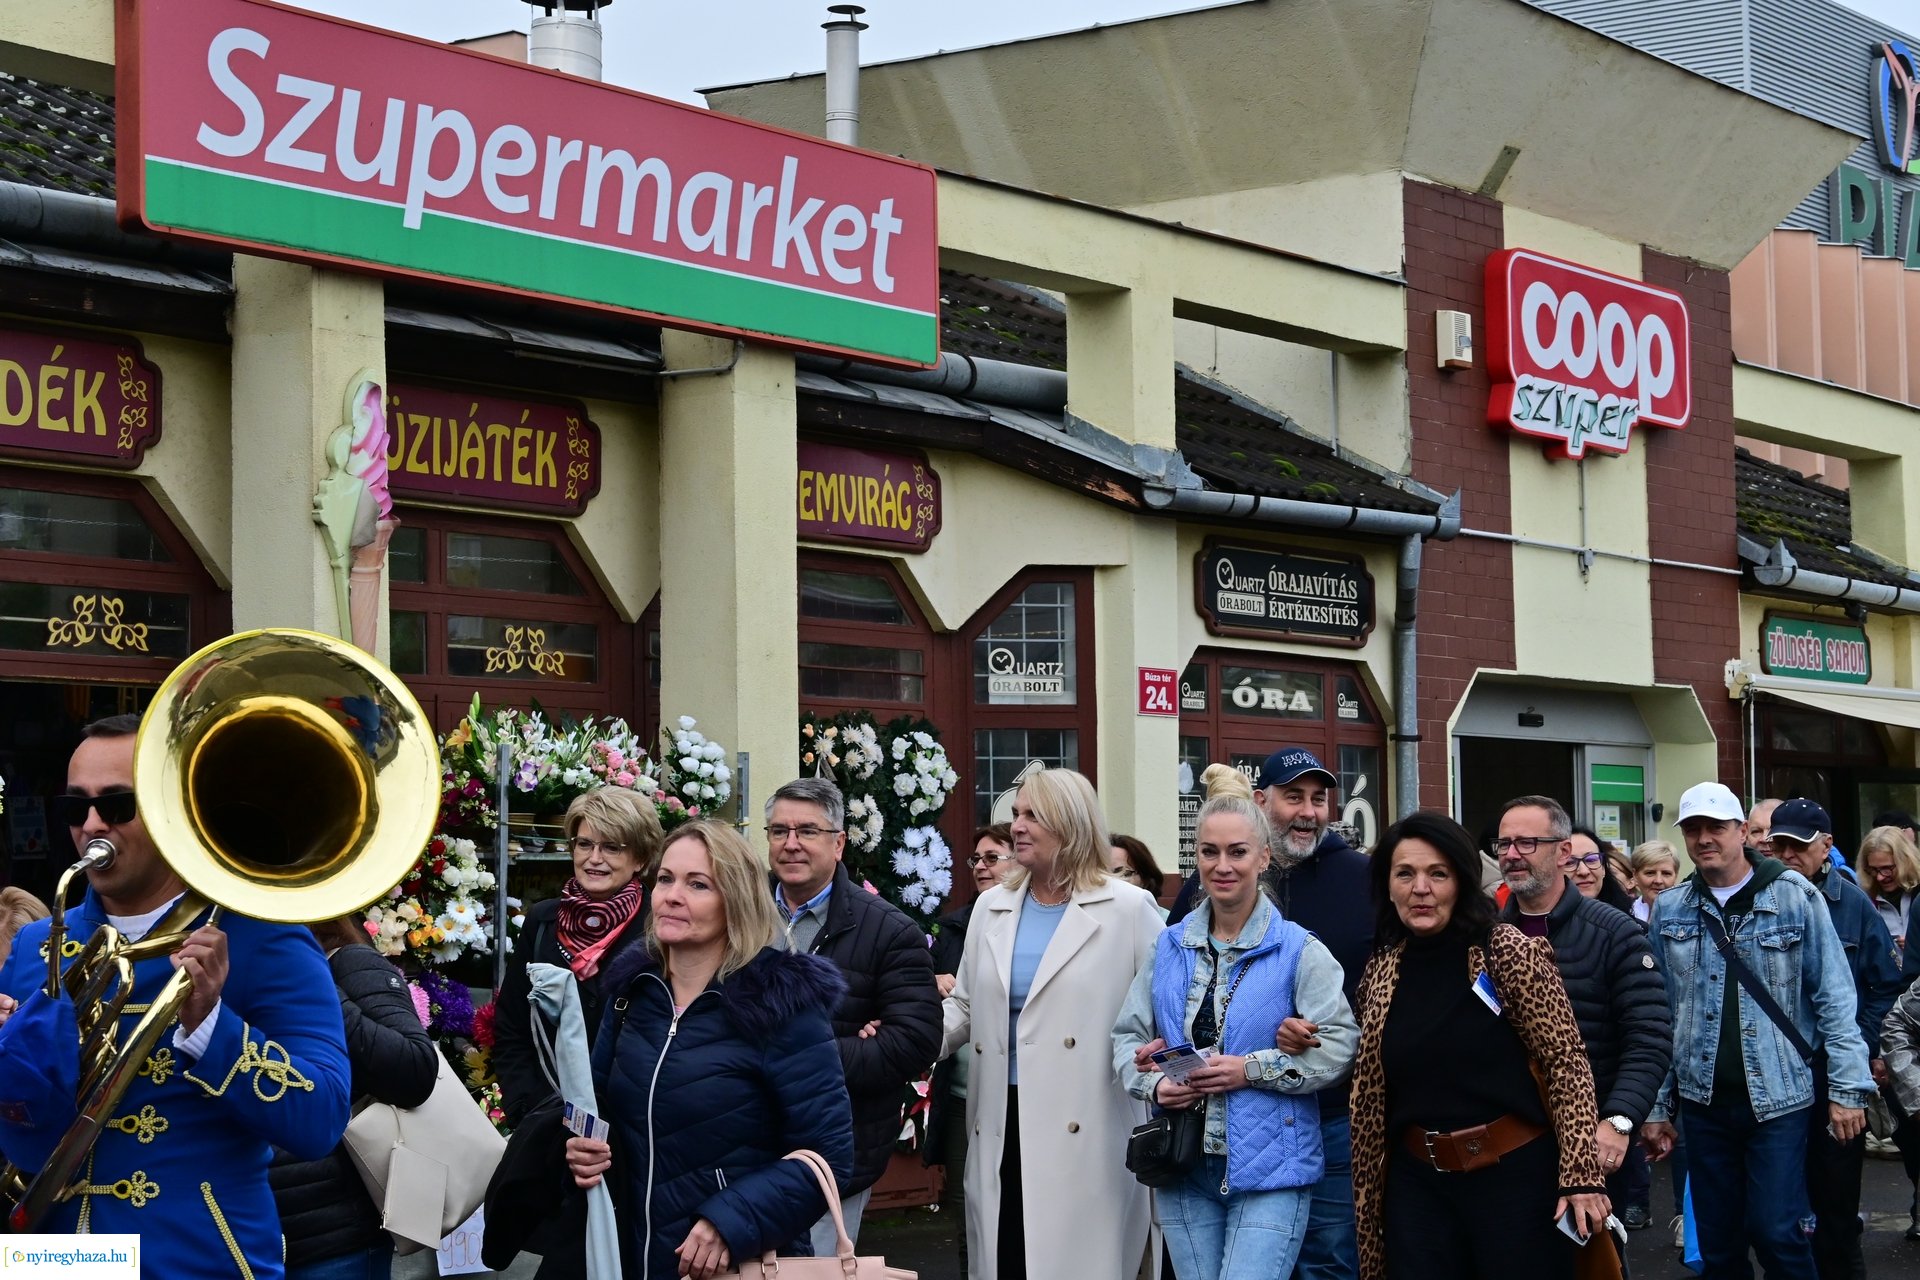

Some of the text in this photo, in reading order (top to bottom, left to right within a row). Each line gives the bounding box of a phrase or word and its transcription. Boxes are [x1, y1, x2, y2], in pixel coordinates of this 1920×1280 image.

[196, 28, 903, 294] Szupermarket
[0, 344, 107, 436] DÉK
[1513, 383, 1640, 448] szuper
[799, 464, 913, 531] EMVIRÁG
[1268, 564, 1358, 600] ÓRAJAVÍTÁS
[1219, 593, 1264, 613] ÓRABOLT
[1268, 597, 1359, 627] ÉRTÉKESÍTÉS
[1768, 626, 1867, 675] ZÖLDSÉG SAROK
[992, 676, 1060, 693] ÓRABOLT
[1144, 672, 1172, 683] Búza tér
[1232, 677, 1314, 713] ÓRA
[1145, 685, 1173, 711] 24.
[1237, 759, 1261, 782] ÓRA
